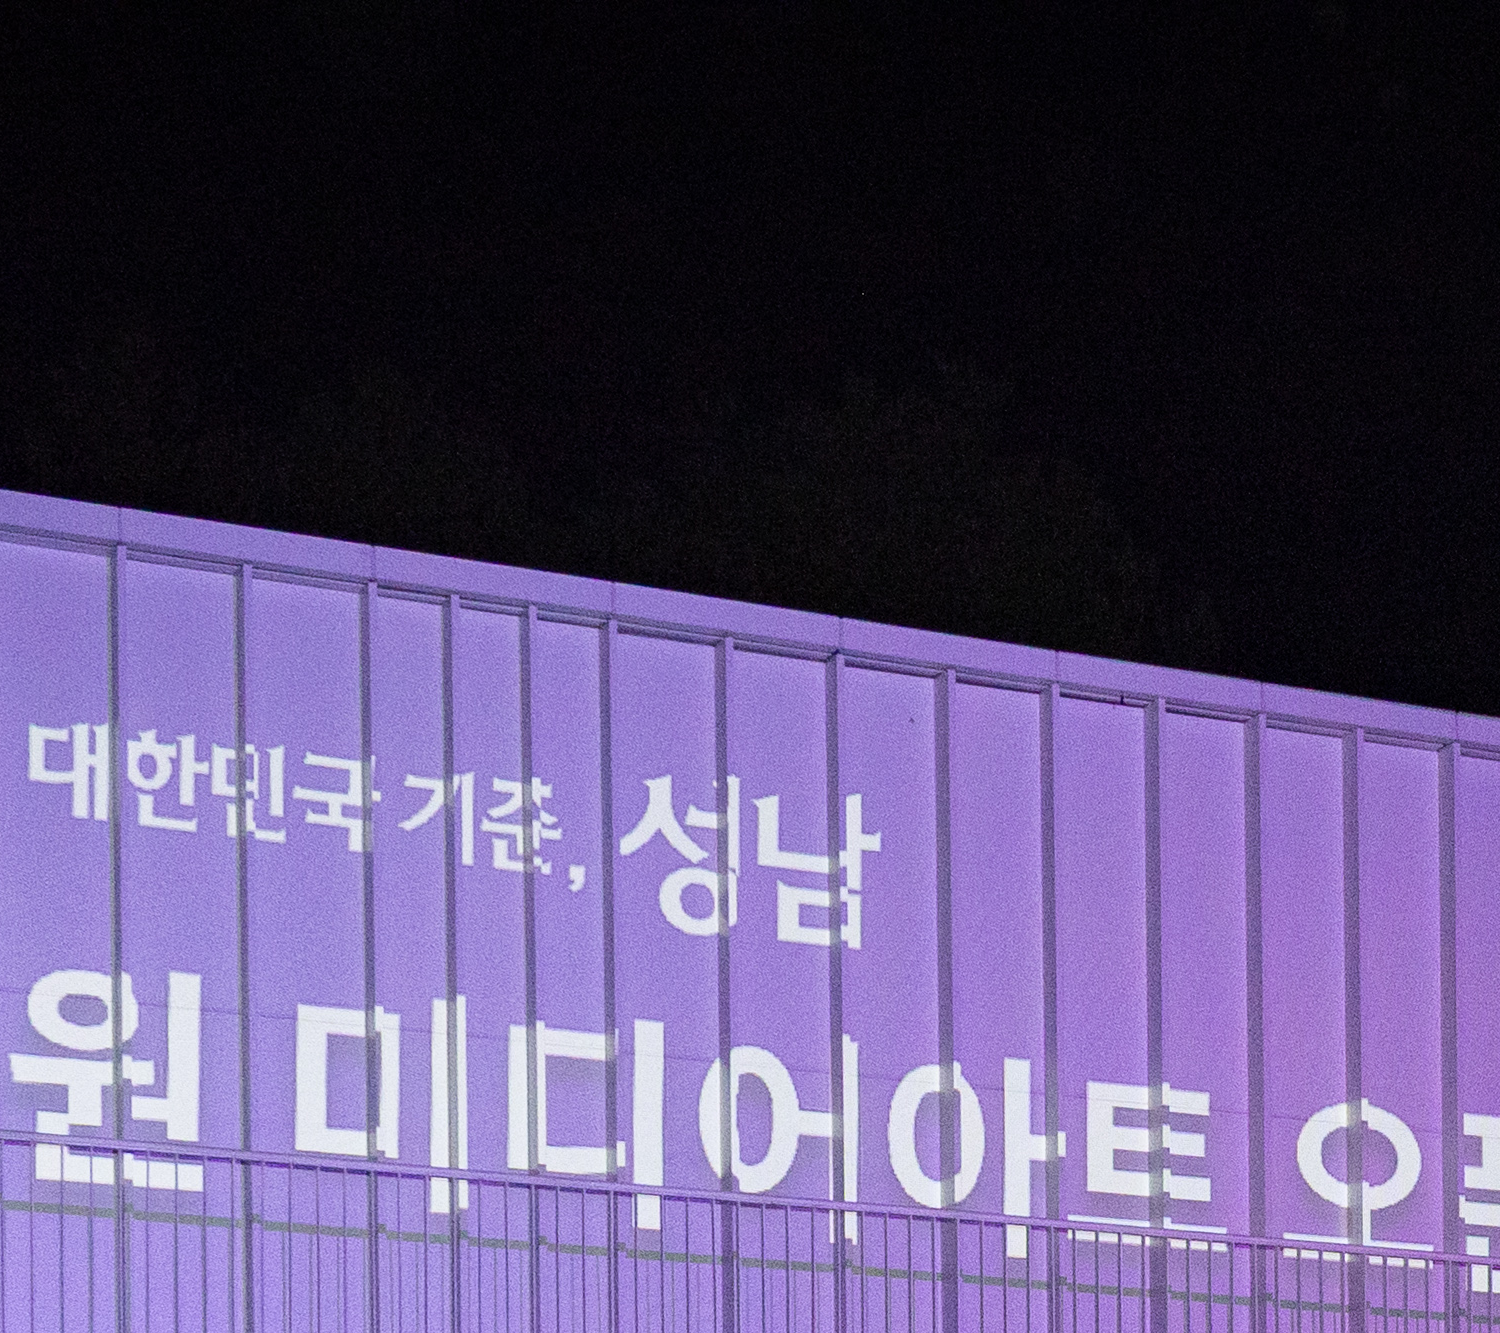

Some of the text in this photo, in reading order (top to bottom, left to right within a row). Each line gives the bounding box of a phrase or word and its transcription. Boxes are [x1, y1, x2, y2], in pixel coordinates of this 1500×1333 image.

[27, 720, 884, 951] 대한민국 기준, 성남
[292, 994, 1229, 1260] 미디어아트
